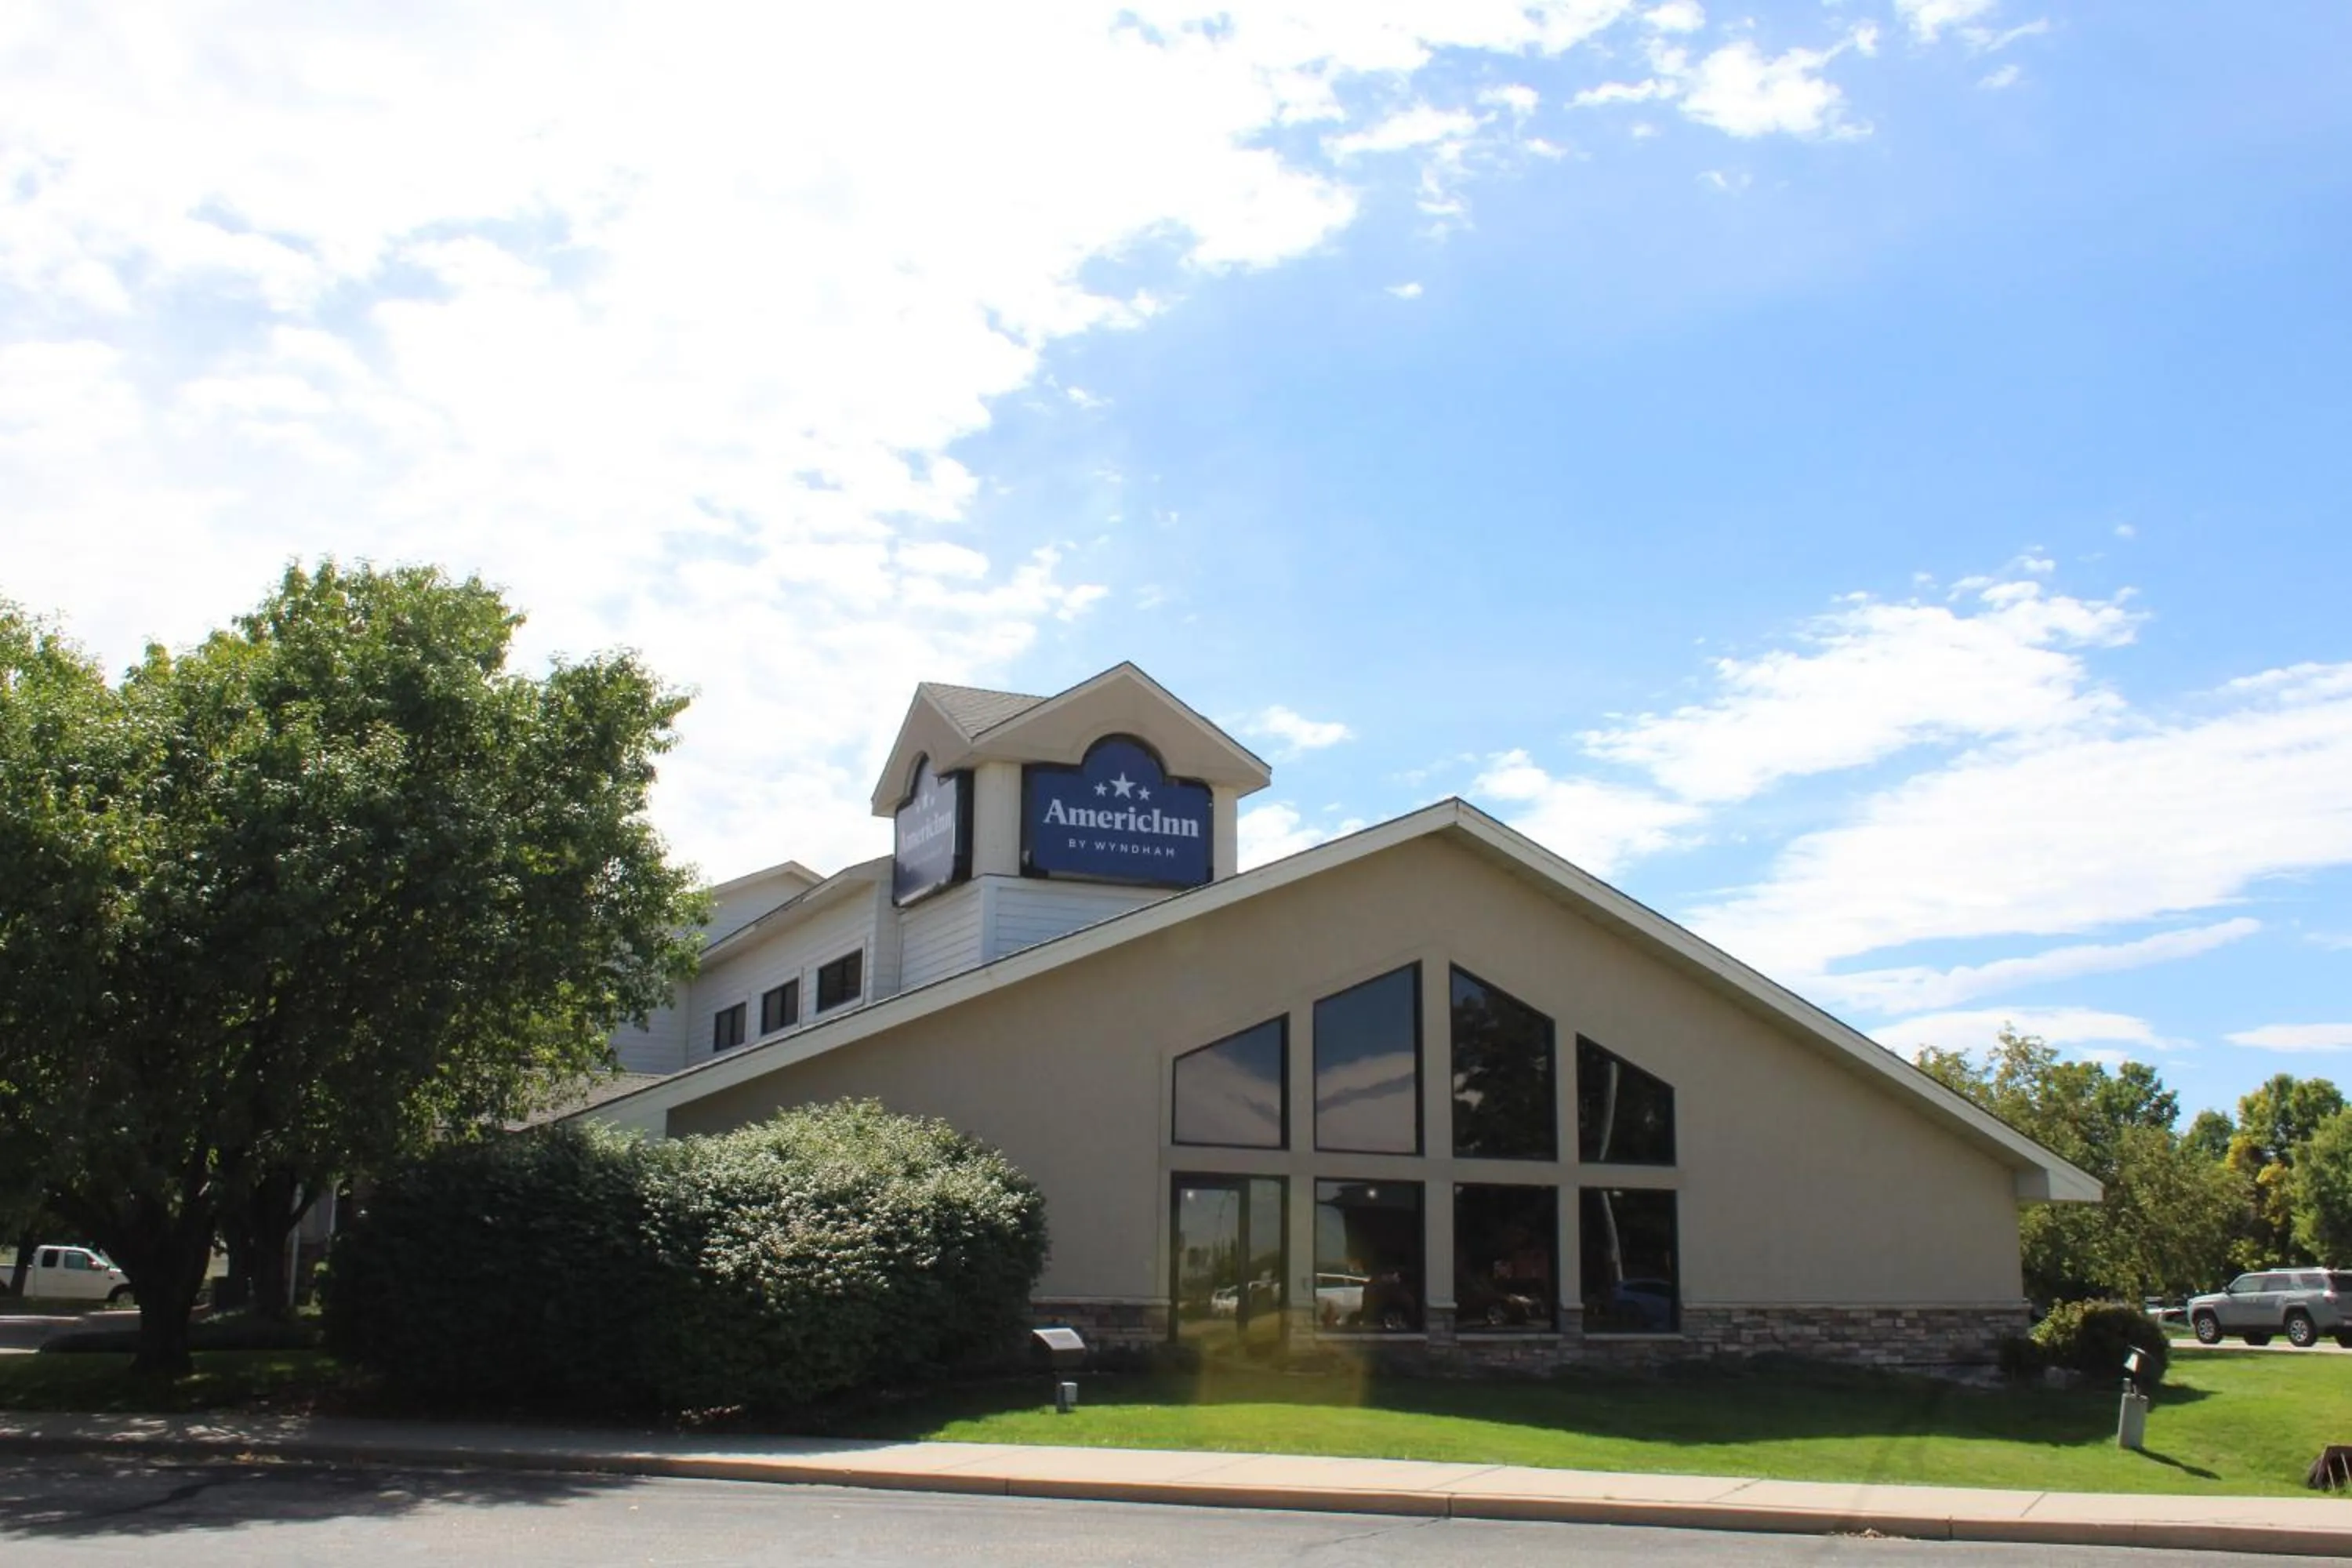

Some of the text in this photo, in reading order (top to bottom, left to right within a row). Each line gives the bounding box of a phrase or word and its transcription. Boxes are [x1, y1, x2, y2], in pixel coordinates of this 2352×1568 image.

[1043, 798, 1199, 837] AmericInn
[1068, 838, 1175, 858] BY WYNDHAM
